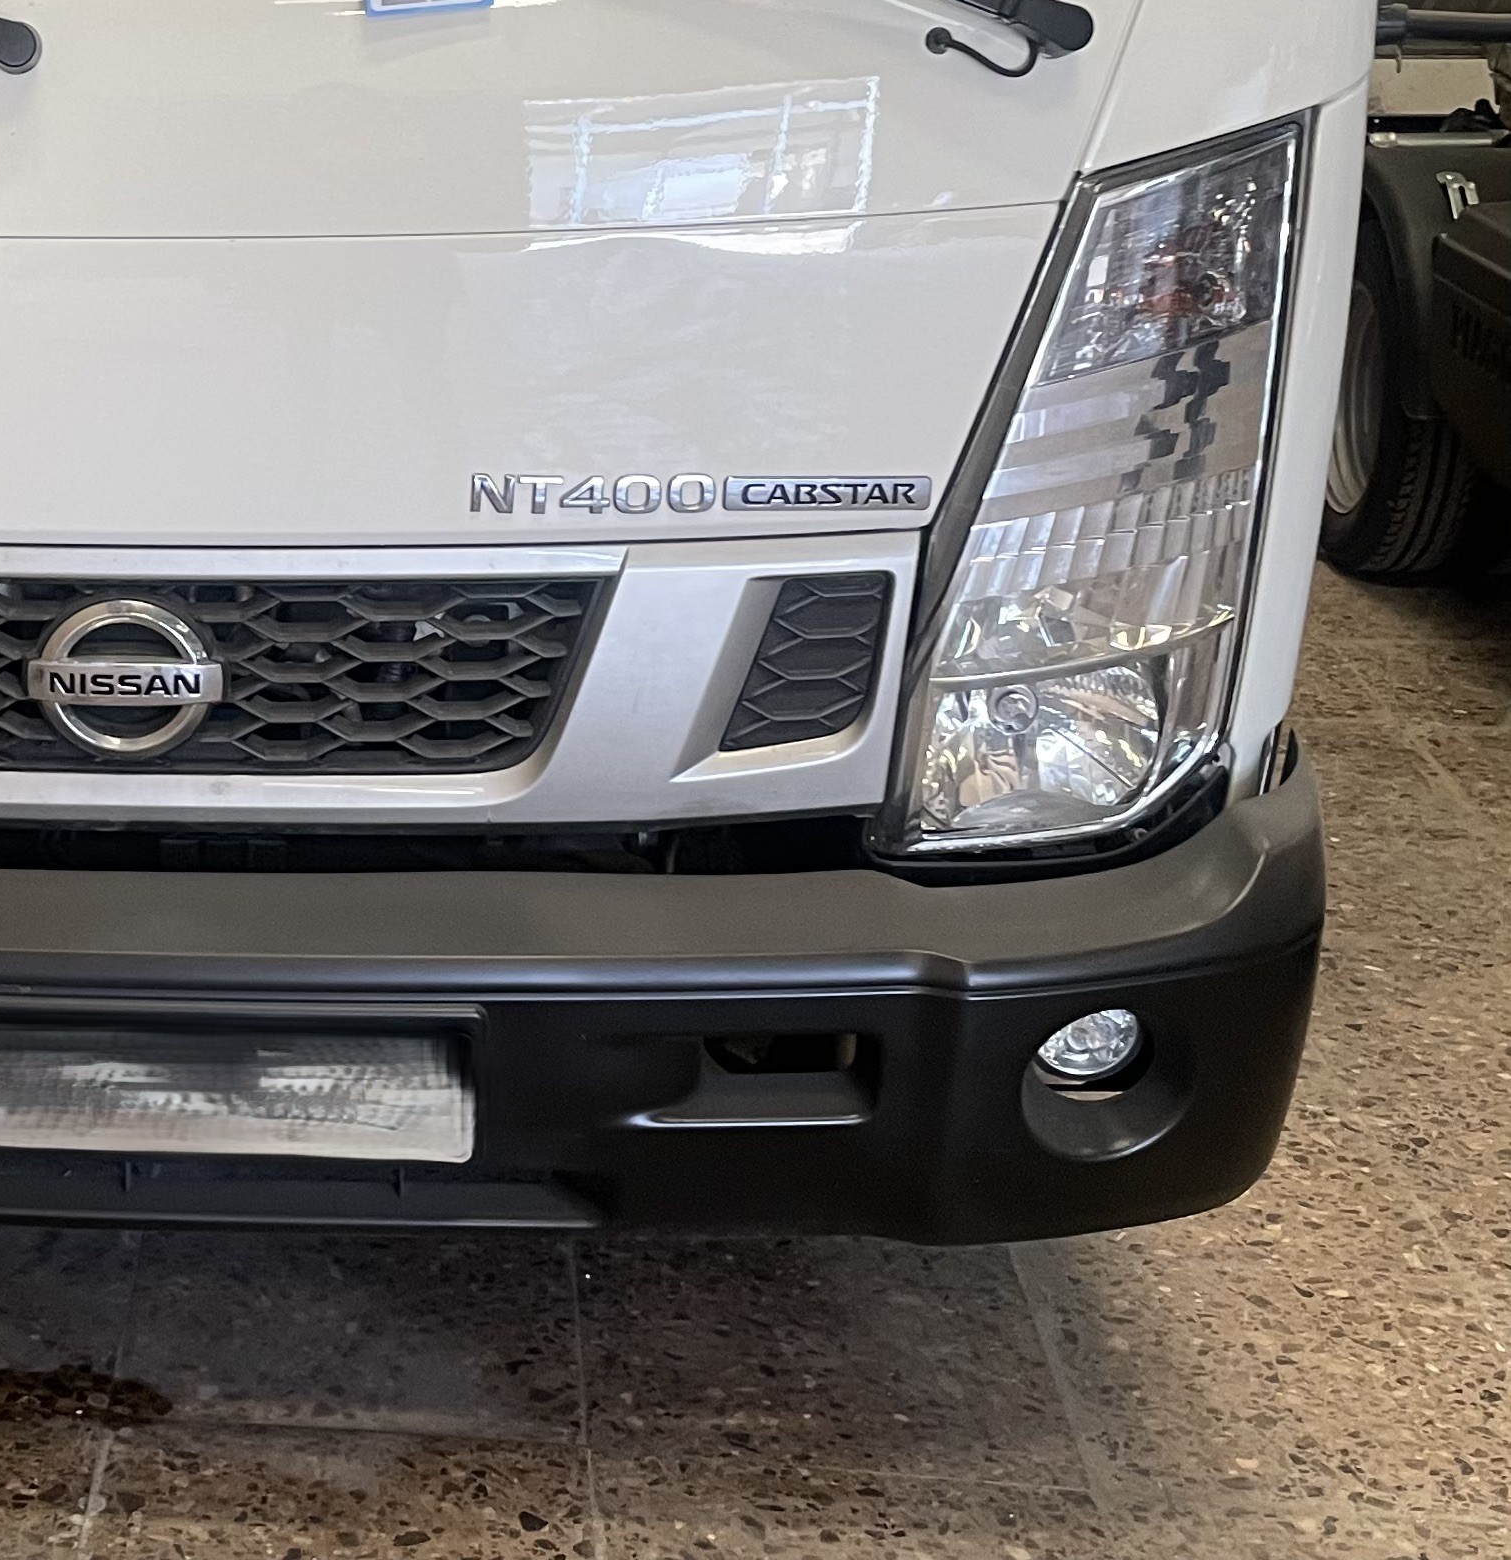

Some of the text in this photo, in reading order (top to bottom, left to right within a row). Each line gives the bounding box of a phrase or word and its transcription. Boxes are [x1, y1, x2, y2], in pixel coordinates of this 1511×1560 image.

[469, 472, 917, 515] NT400 CABSTAR
[48, 671, 202, 697] NISSAN
